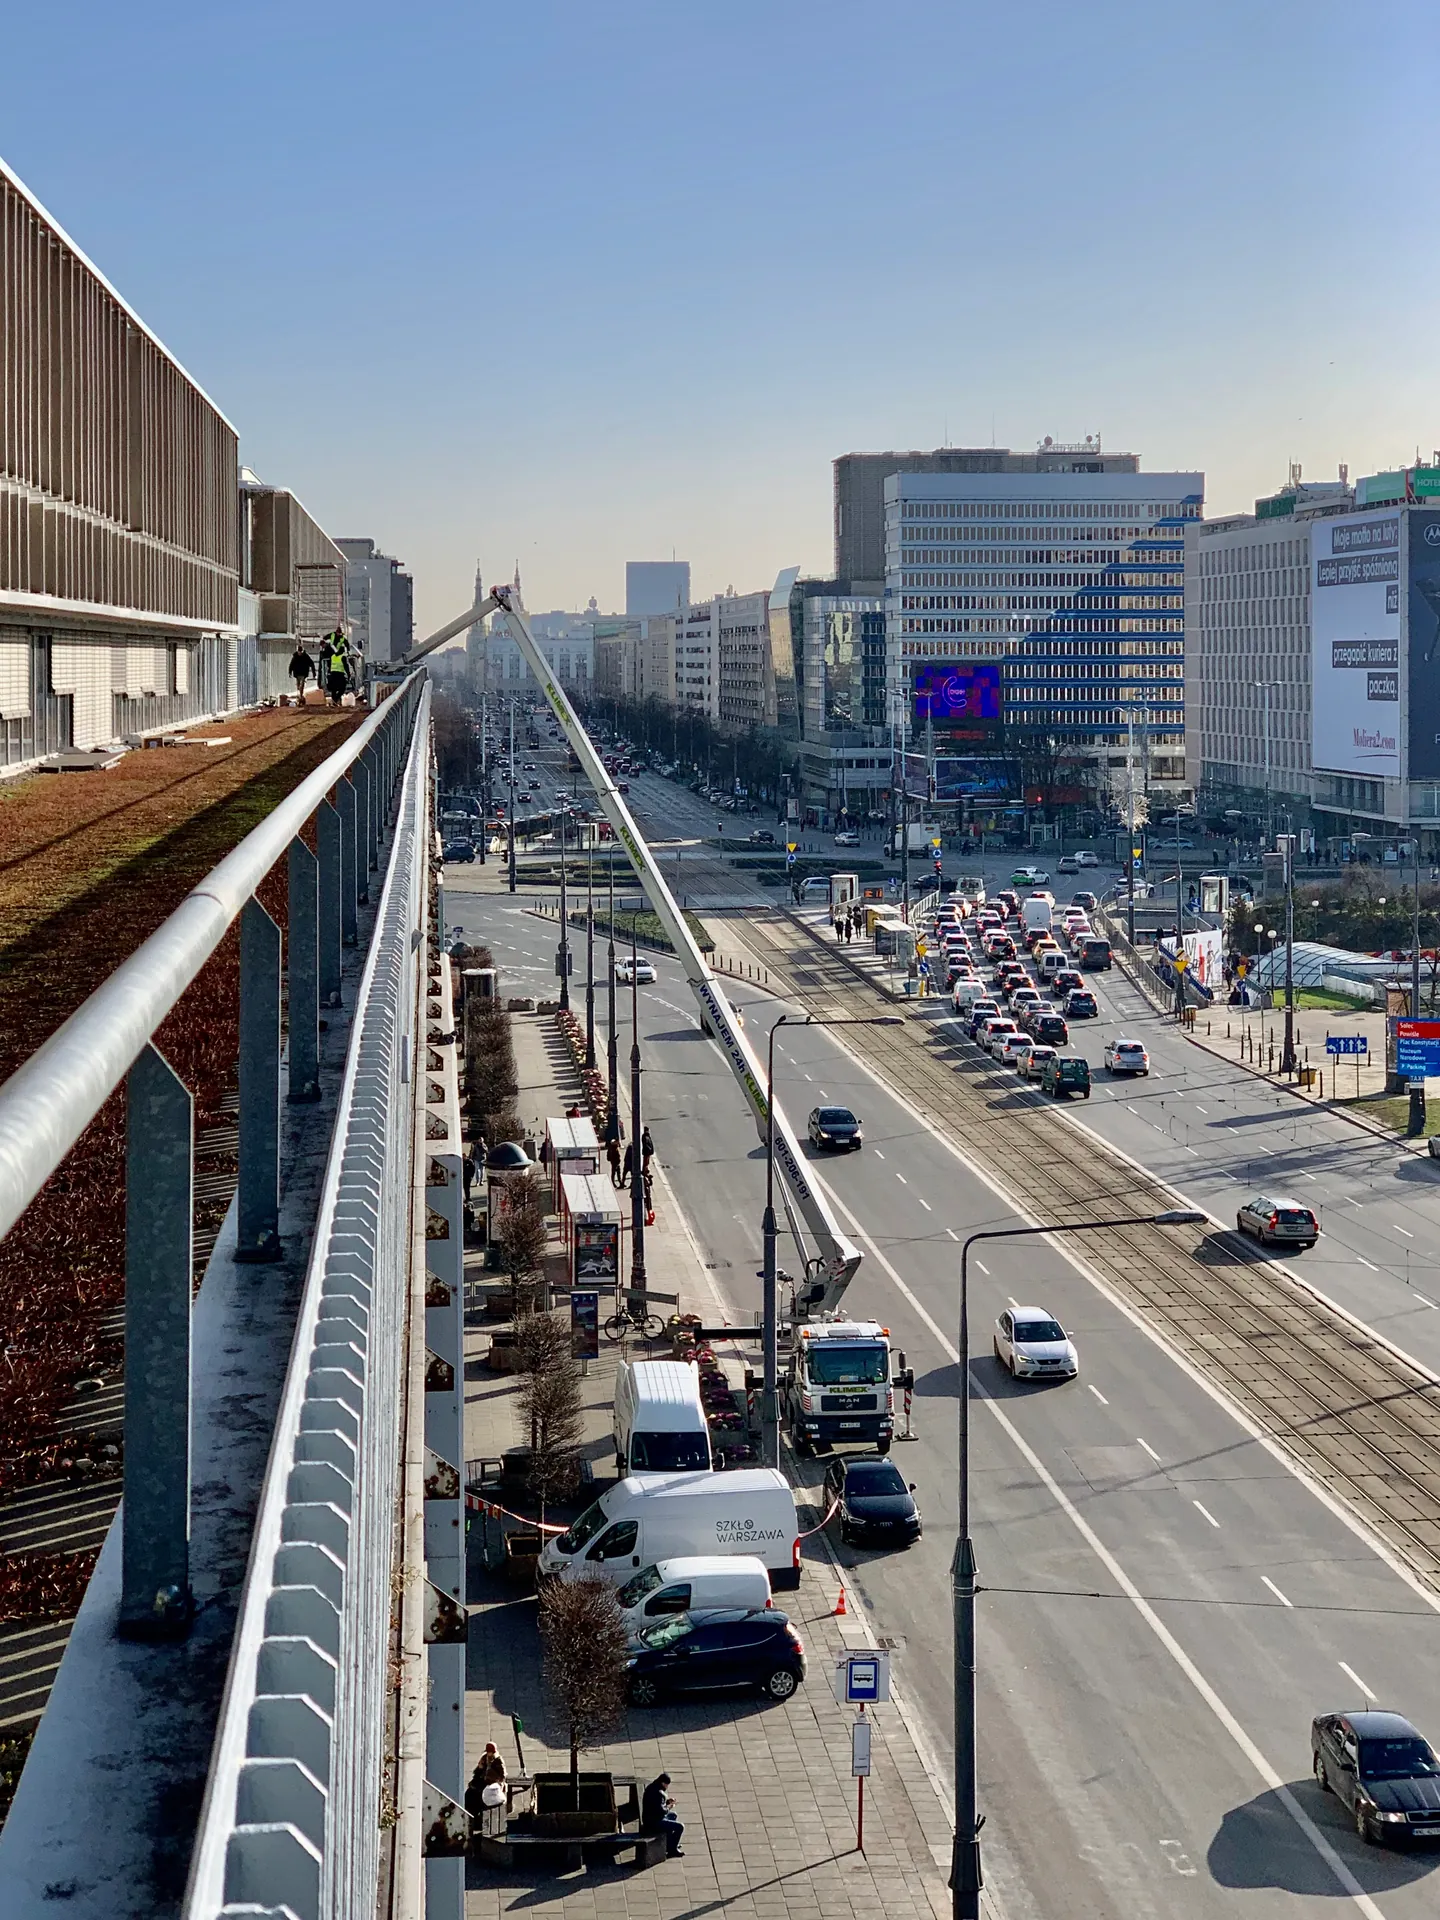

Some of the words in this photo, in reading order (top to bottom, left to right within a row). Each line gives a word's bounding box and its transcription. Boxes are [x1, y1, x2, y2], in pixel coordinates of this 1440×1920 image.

[1333, 528, 1350, 549] Moje
[1351, 525, 1370, 544] motto
[1372, 527, 1382, 541] na
[1383, 522, 1398, 544] luty:
[1319, 561, 1337, 584] Lepiej
[1339, 558, 1361, 582] przyjść
[1387, 590, 1398, 609] niż
[1333, 642, 1366, 666] przegapić
[1367, 643, 1392, 662] kuriera
[1393, 647, 1397, 661] z
[1369, 676, 1397, 698] paczką.
[1353, 727, 1396, 750] Moliera2.com
[620, 825, 645, 870] KLIMEX
[700, 984, 734, 1049] WYNAJEM
[731, 1049, 746, 1074] 24h
[774, 1136, 810, 1200] 601-206-191
[829, 1386, 868, 1394] KLIMEX
[716, 1519, 754, 1532] SZKŁO
[716, 1529, 785, 1543] WARSZAWA
